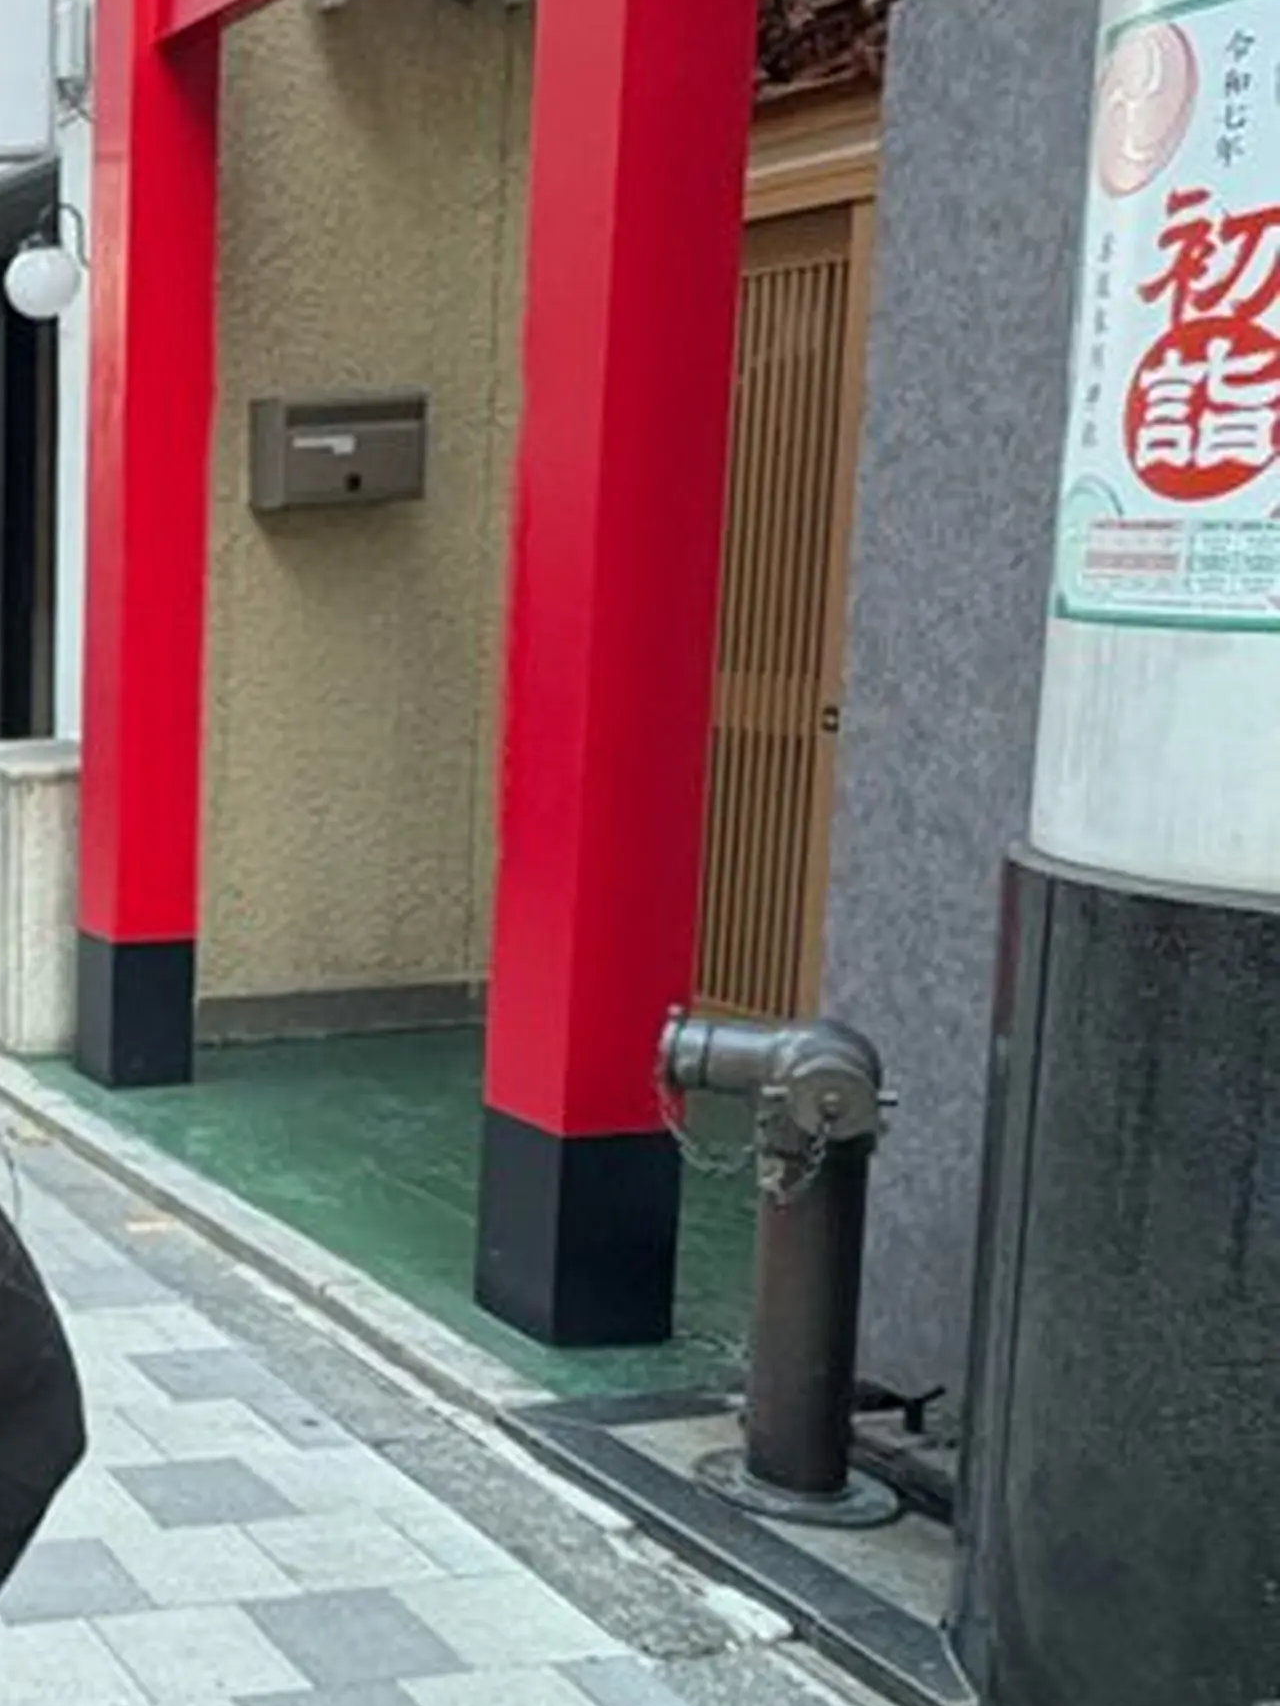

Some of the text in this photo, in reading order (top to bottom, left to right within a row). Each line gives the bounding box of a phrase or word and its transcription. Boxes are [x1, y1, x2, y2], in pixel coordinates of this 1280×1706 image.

[1214, 29, 1256, 169] 令和七年
[1138, 188, 1280, 470] 初詣
